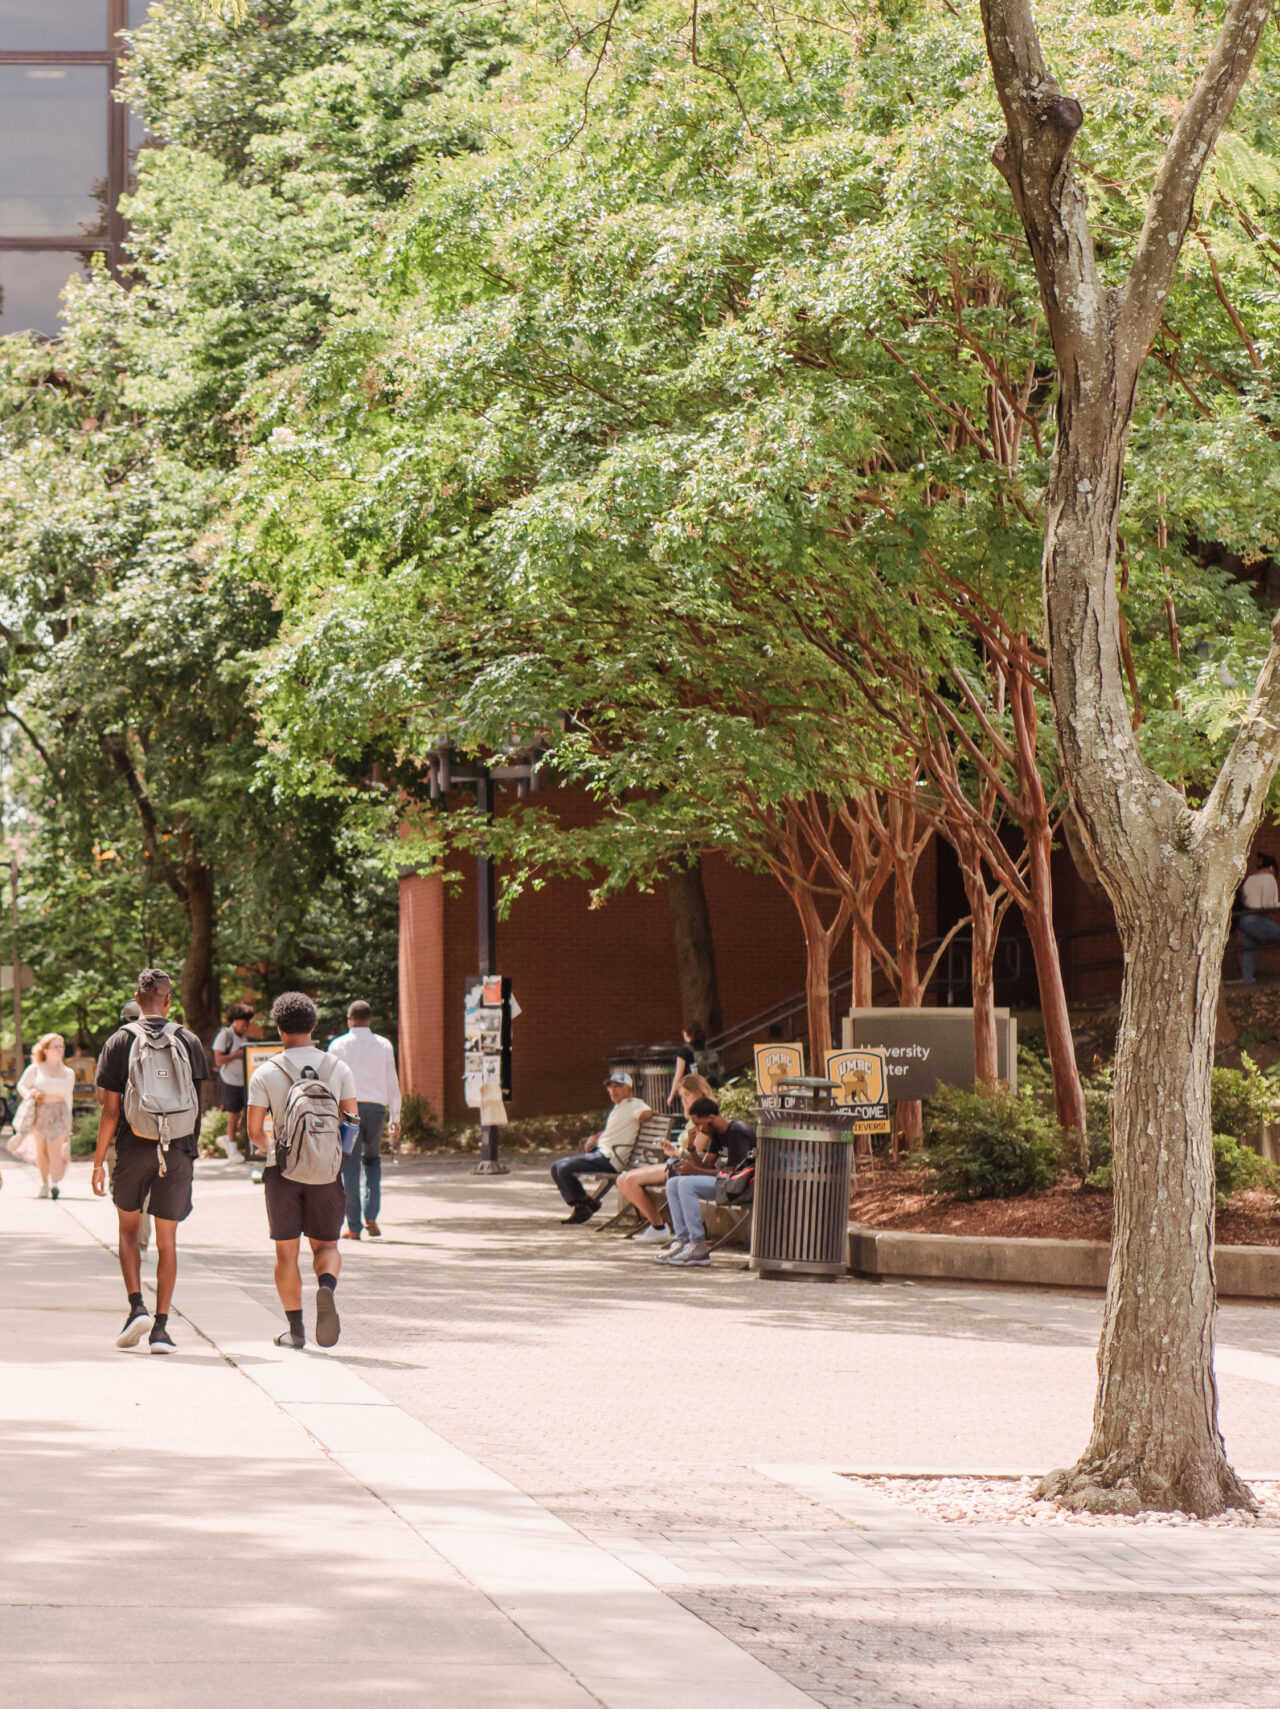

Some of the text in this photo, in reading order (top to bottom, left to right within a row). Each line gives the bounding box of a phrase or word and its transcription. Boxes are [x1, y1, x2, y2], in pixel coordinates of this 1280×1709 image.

[766, 1053, 793, 1069] UMBC
[861, 1044, 930, 1061] versity
[838, 1059, 872, 1076] UMBC
